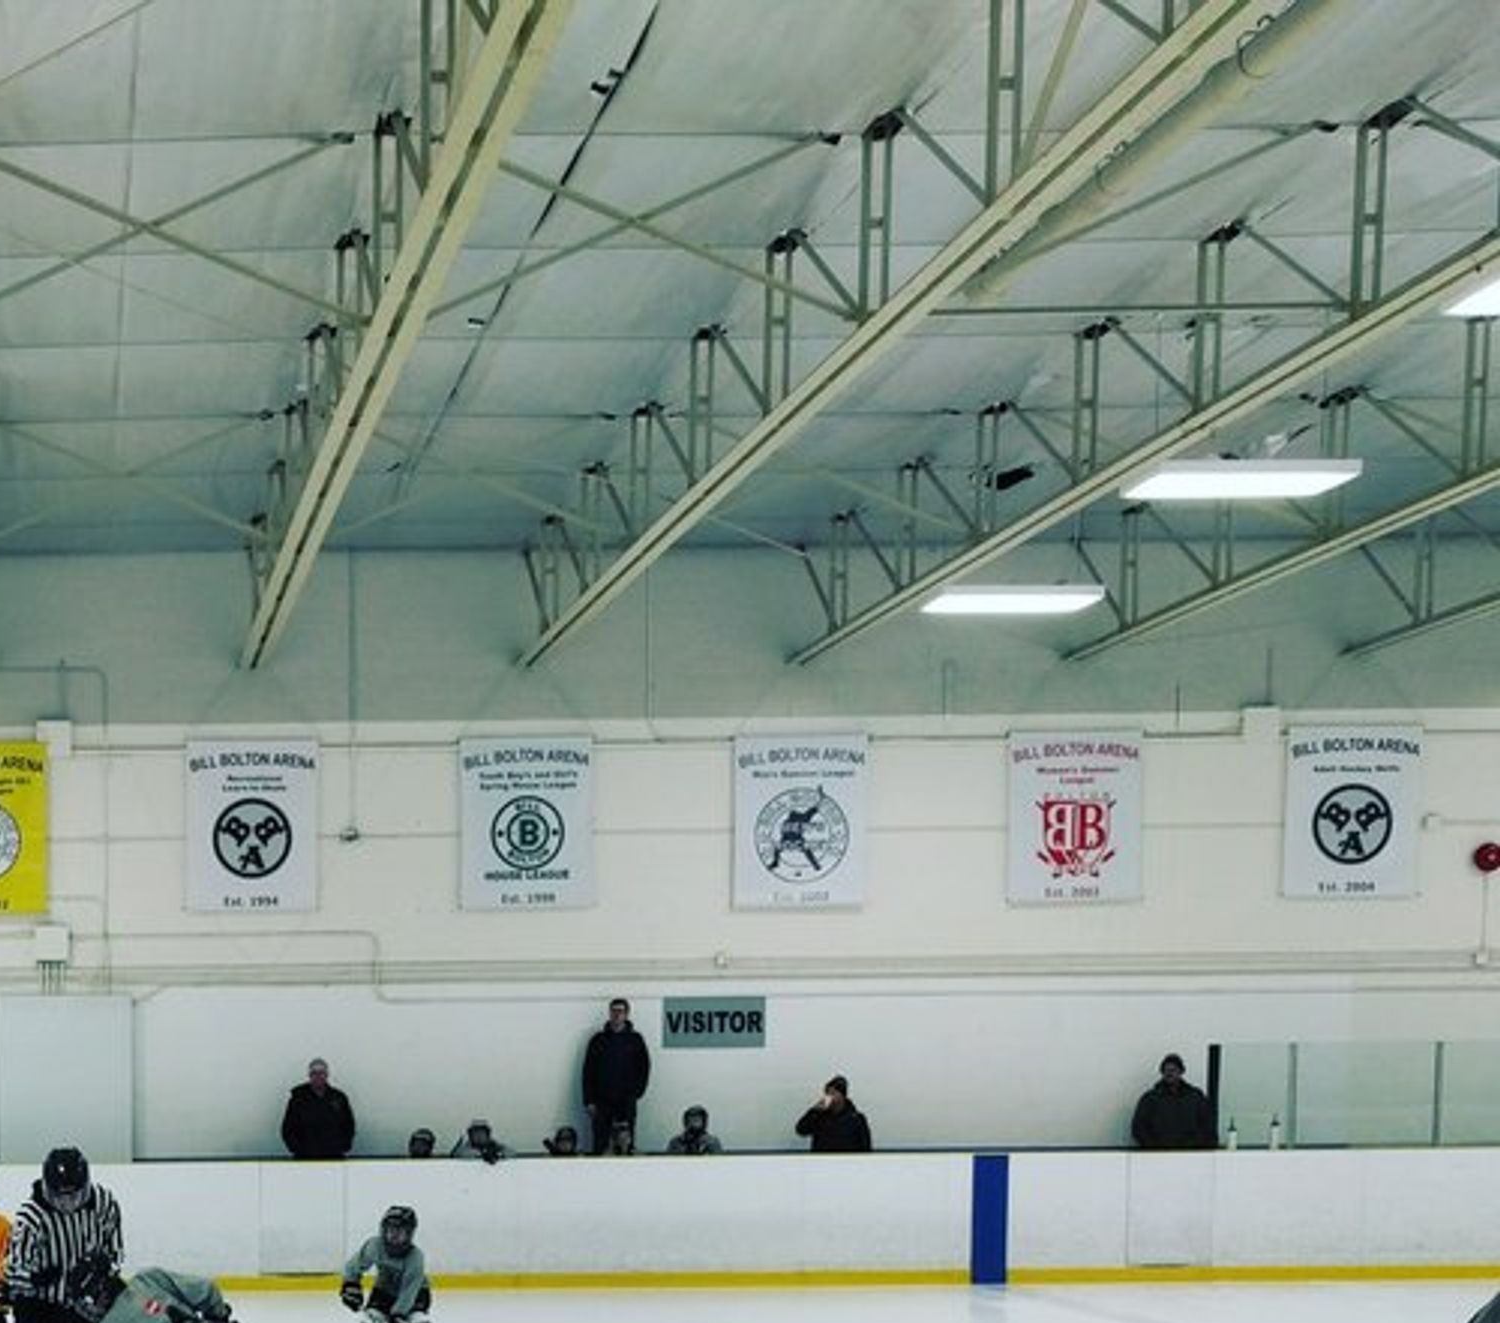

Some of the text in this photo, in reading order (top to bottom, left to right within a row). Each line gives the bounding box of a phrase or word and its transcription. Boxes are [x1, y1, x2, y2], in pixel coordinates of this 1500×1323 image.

[1013, 743, 1139, 762] BILL BOLTON ARENA
[1292, 738, 1420, 758] BILL BOLTON ARENA
[1, 757, 43, 772] ARENA
[190, 753, 315, 772] BILL BOLTON ARENA
[464, 749, 589, 770] BILL BOLTON ARENA
[738, 749, 865, 768] BILL BOLTON ARENA
[519, 819, 539, 846] B
[485, 870, 569, 881] HOUSE LEAGUE
[666, 1010, 763, 1034] VISITOR
